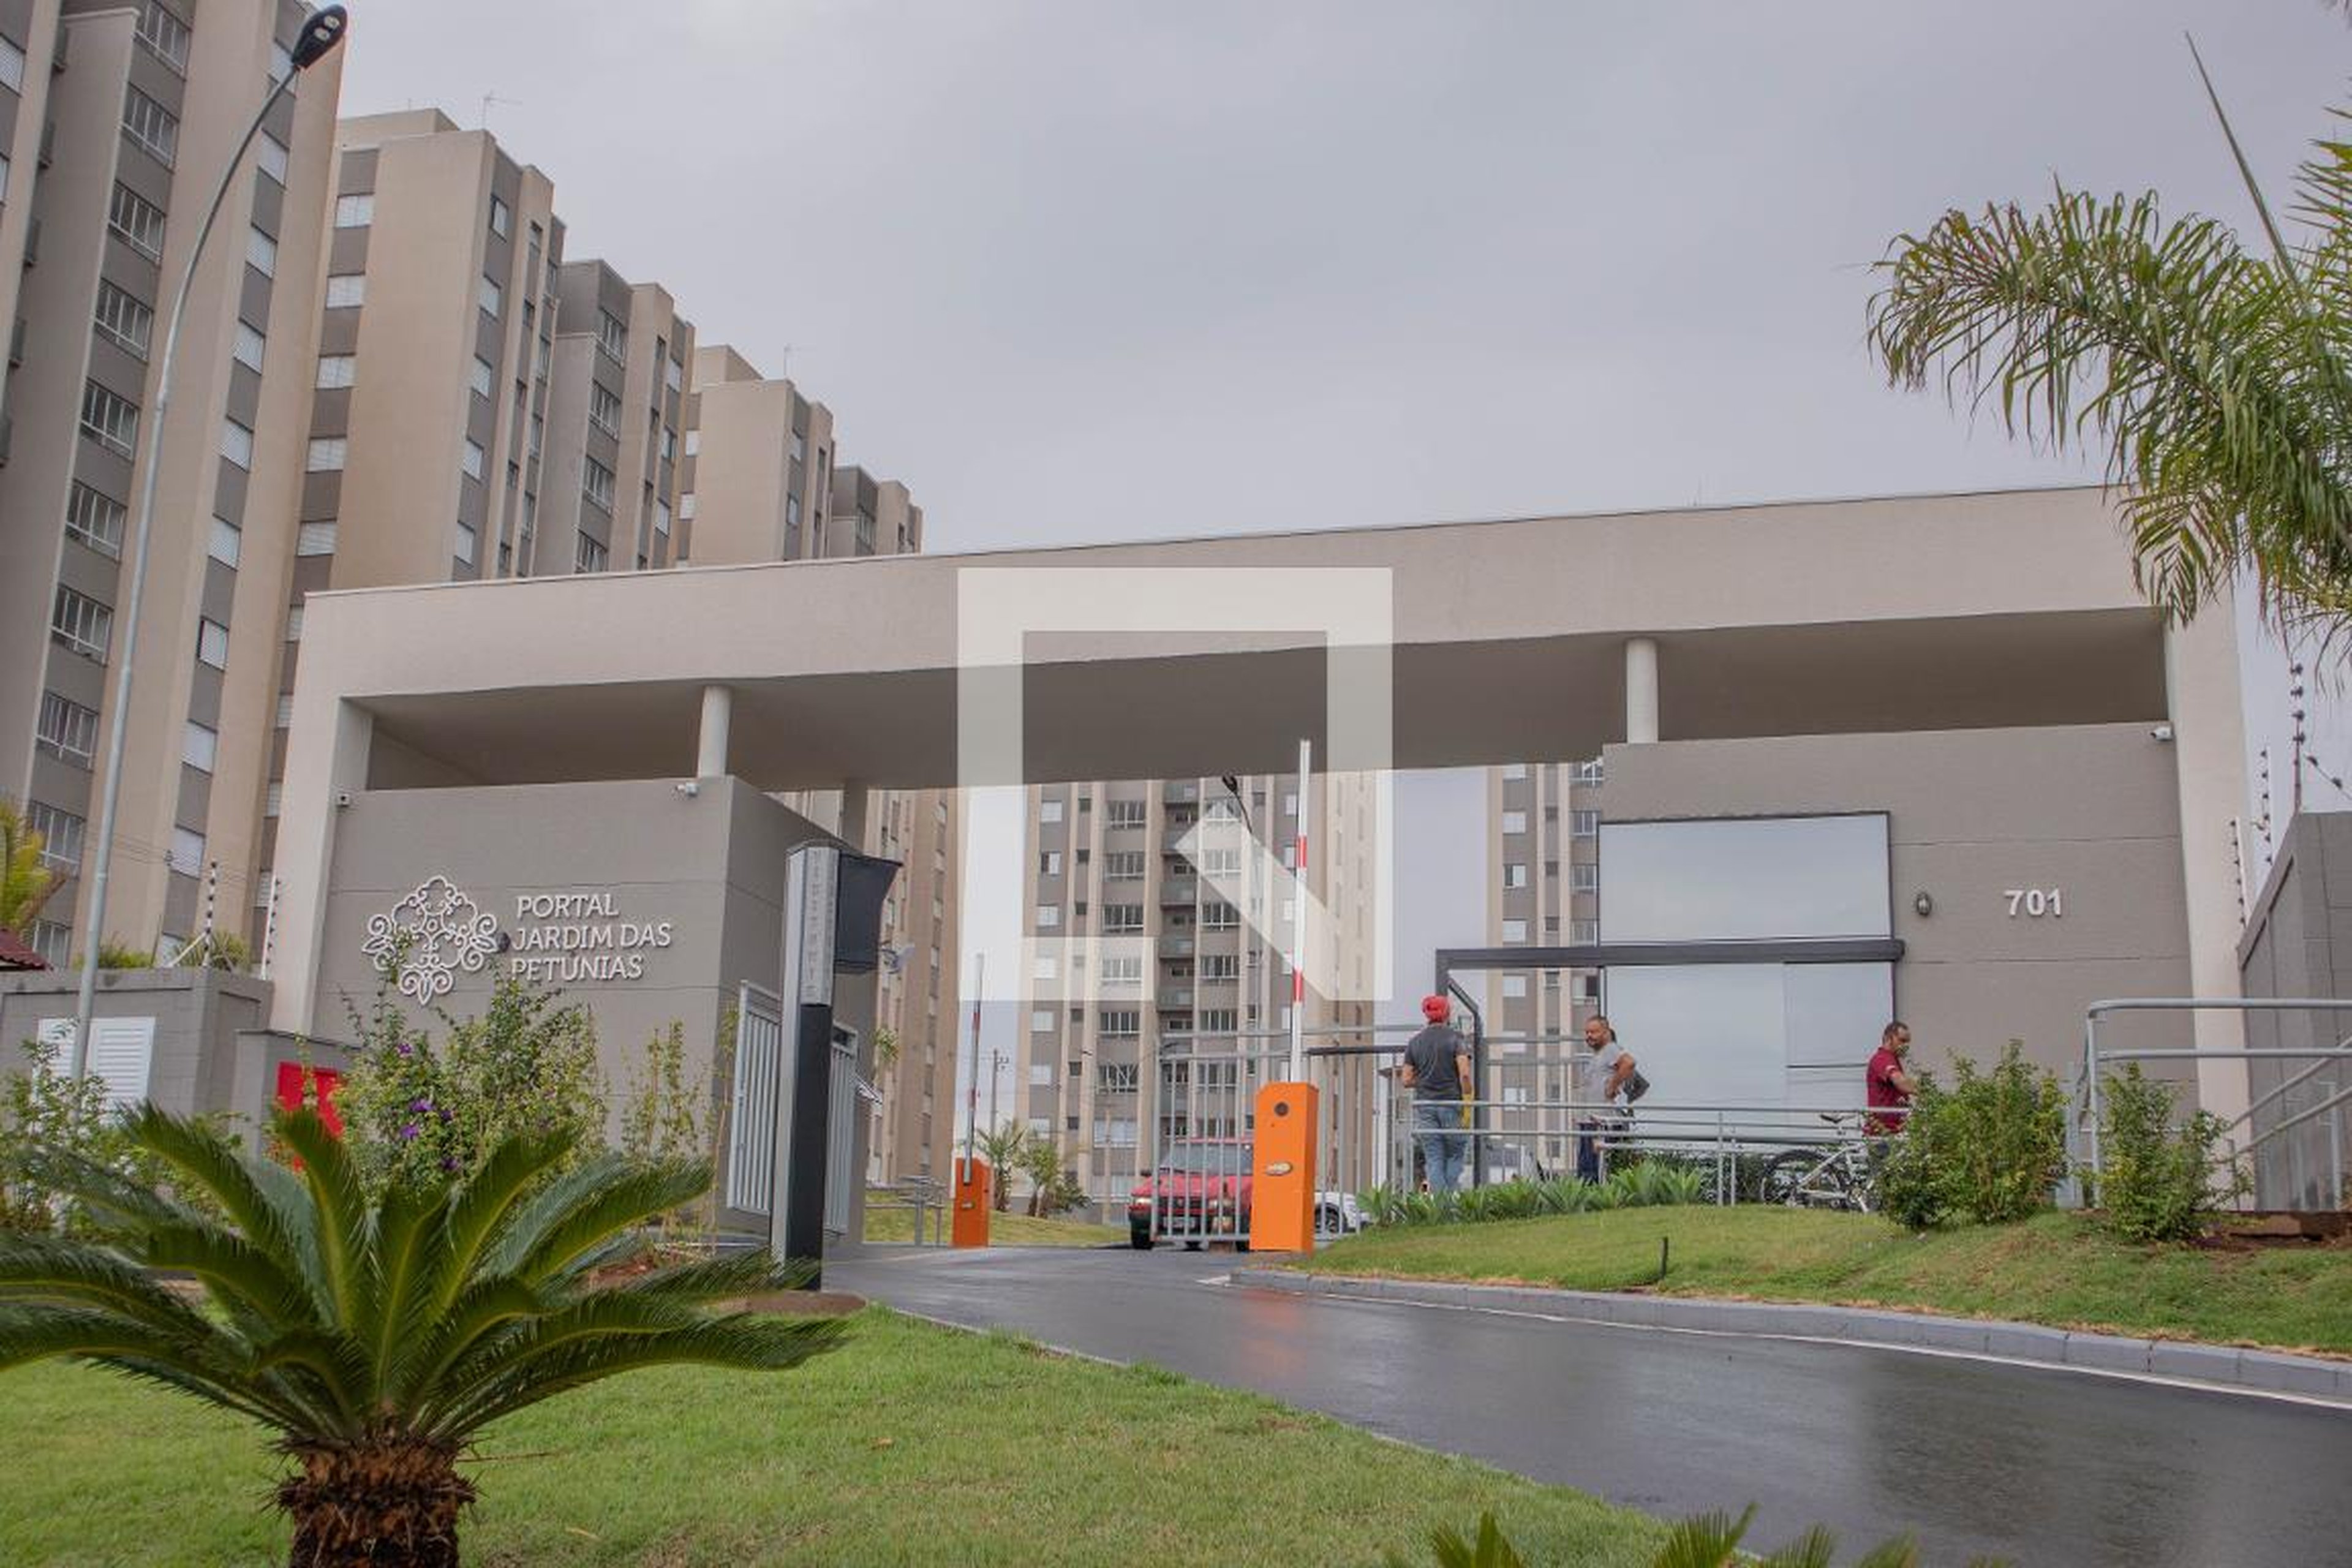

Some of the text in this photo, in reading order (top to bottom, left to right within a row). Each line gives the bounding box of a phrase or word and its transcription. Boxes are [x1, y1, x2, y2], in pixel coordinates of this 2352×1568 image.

[517, 894, 619, 918] PORTAL
[2003, 888, 2062, 916] 701
[512, 922, 671, 950] JARDIM DAS
